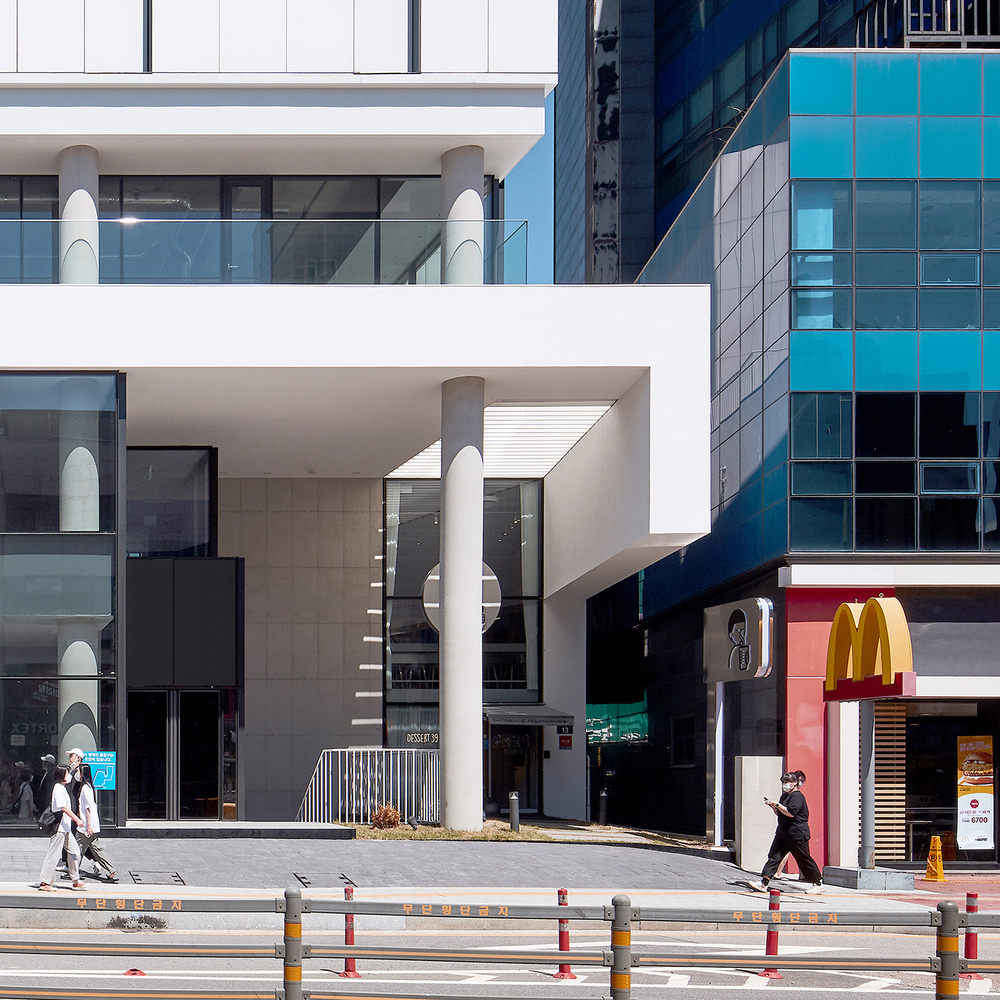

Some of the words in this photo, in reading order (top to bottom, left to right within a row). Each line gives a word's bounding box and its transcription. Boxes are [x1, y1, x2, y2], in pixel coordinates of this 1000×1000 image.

[561, 726, 569, 734] 13
[406, 733, 430, 743] DESSERT
[431, 733, 439, 743] 39
[77, 898, 182, 910] 무단횡단금지
[402, 903, 508, 916] 무단횡단금지
[732, 911, 838, 923] 무단횡단금지
